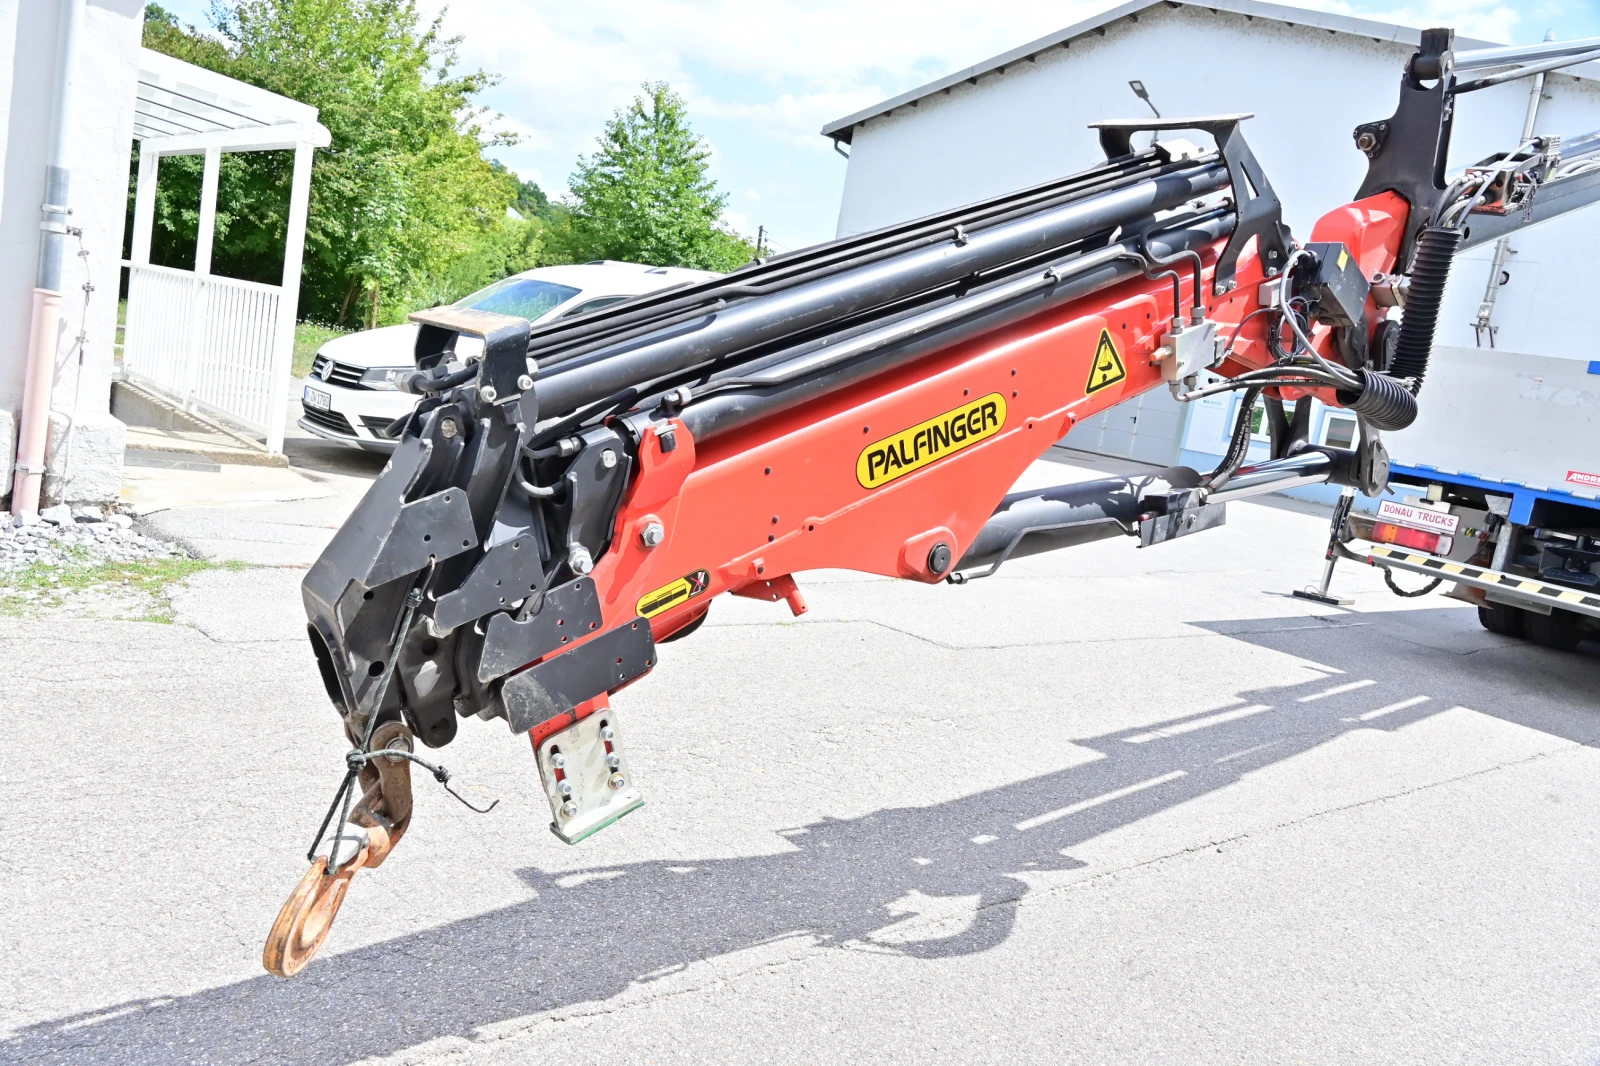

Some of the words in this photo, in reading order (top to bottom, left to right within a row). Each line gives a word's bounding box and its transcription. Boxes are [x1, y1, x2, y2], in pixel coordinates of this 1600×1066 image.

[867, 401, 998, 482] PALFINGER
[1383, 504, 1413, 518] DONAU
[1418, 511, 1454, 527] TRUCKS
